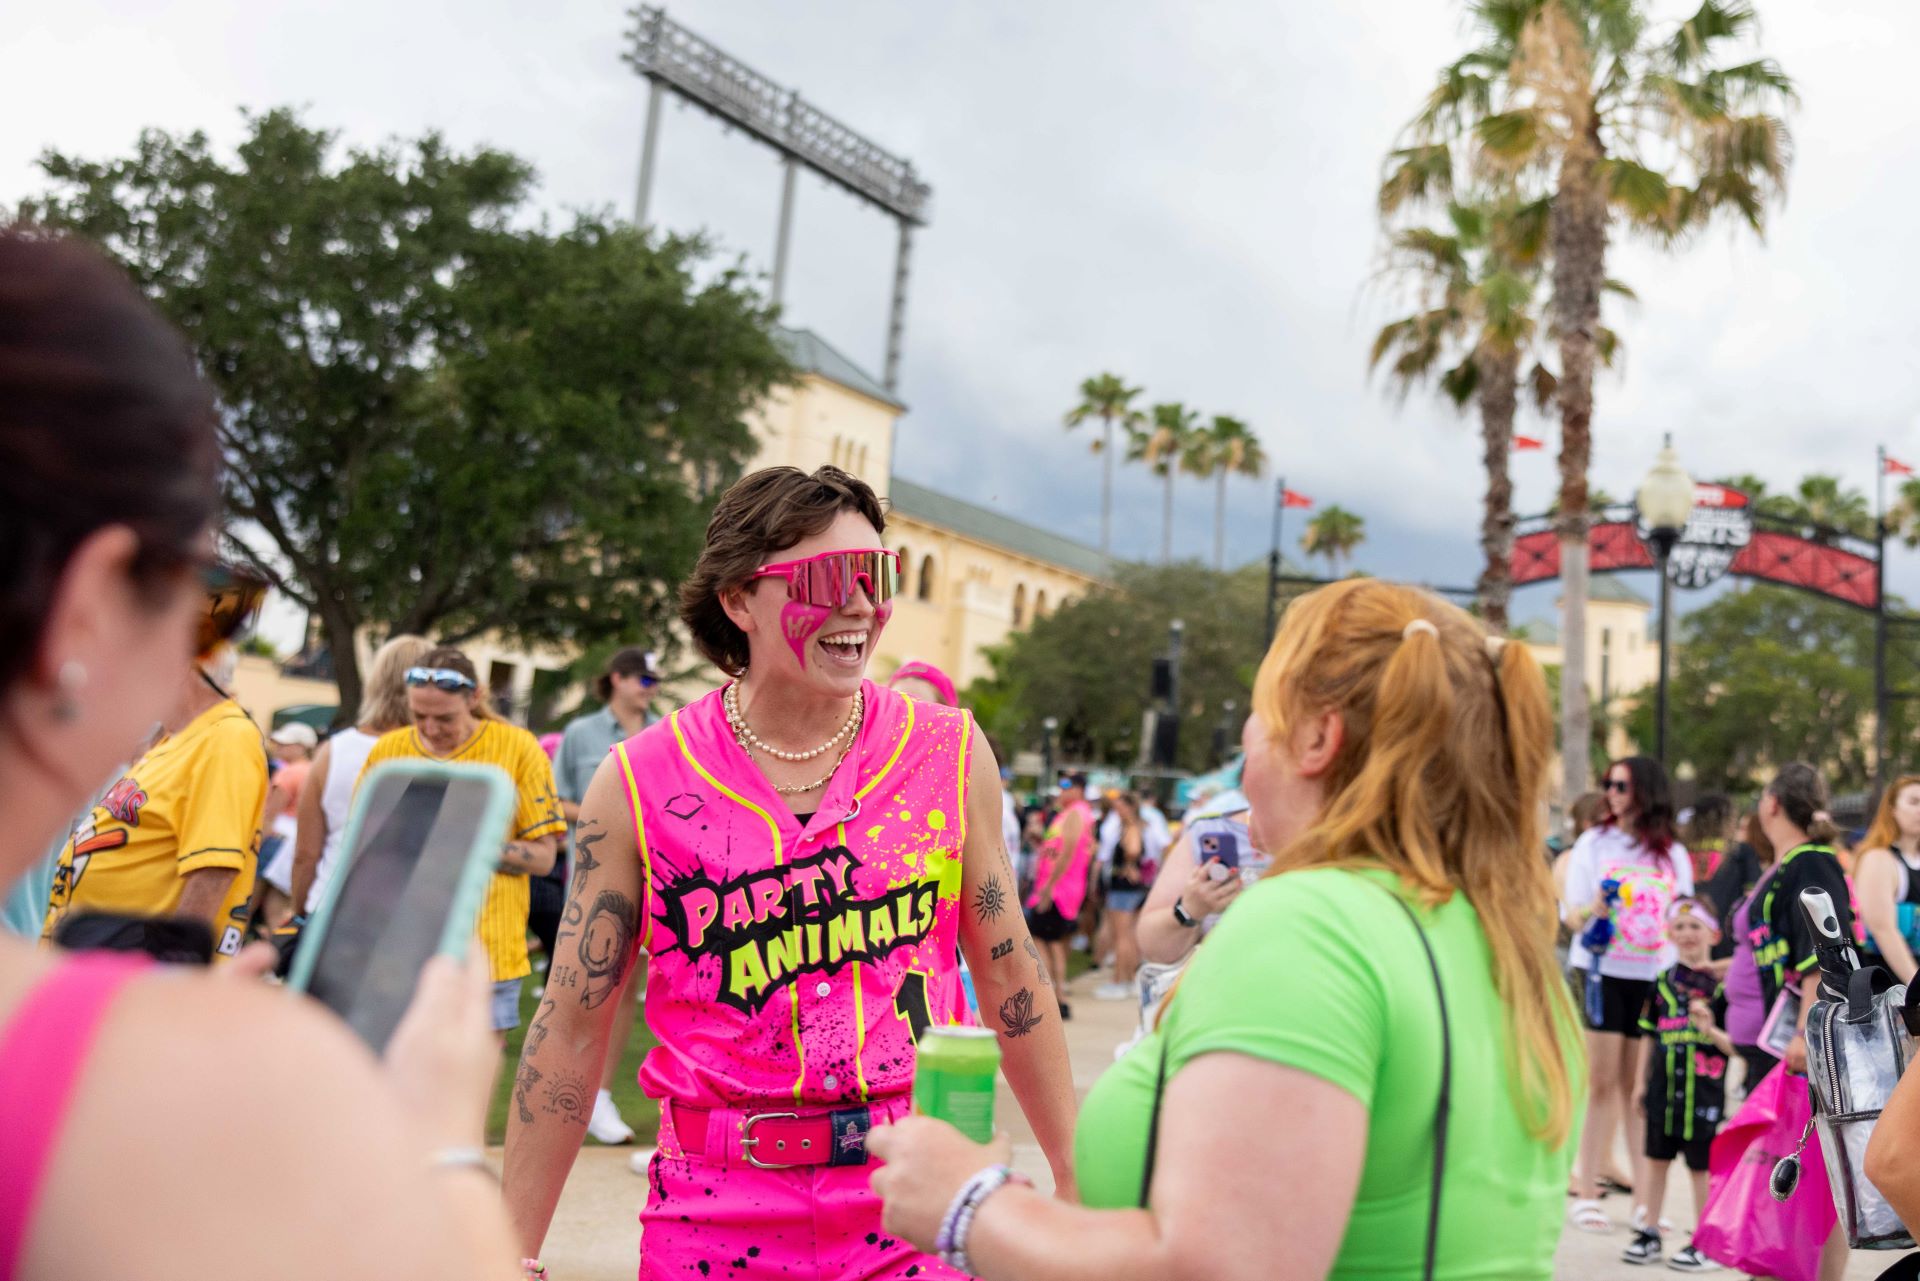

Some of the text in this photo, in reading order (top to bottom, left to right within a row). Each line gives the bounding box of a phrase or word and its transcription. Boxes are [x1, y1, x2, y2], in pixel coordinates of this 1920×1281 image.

[679, 853, 852, 948] PARTY
[729, 889, 934, 1000] ANIMALS
[991, 938, 1014, 961] 222
